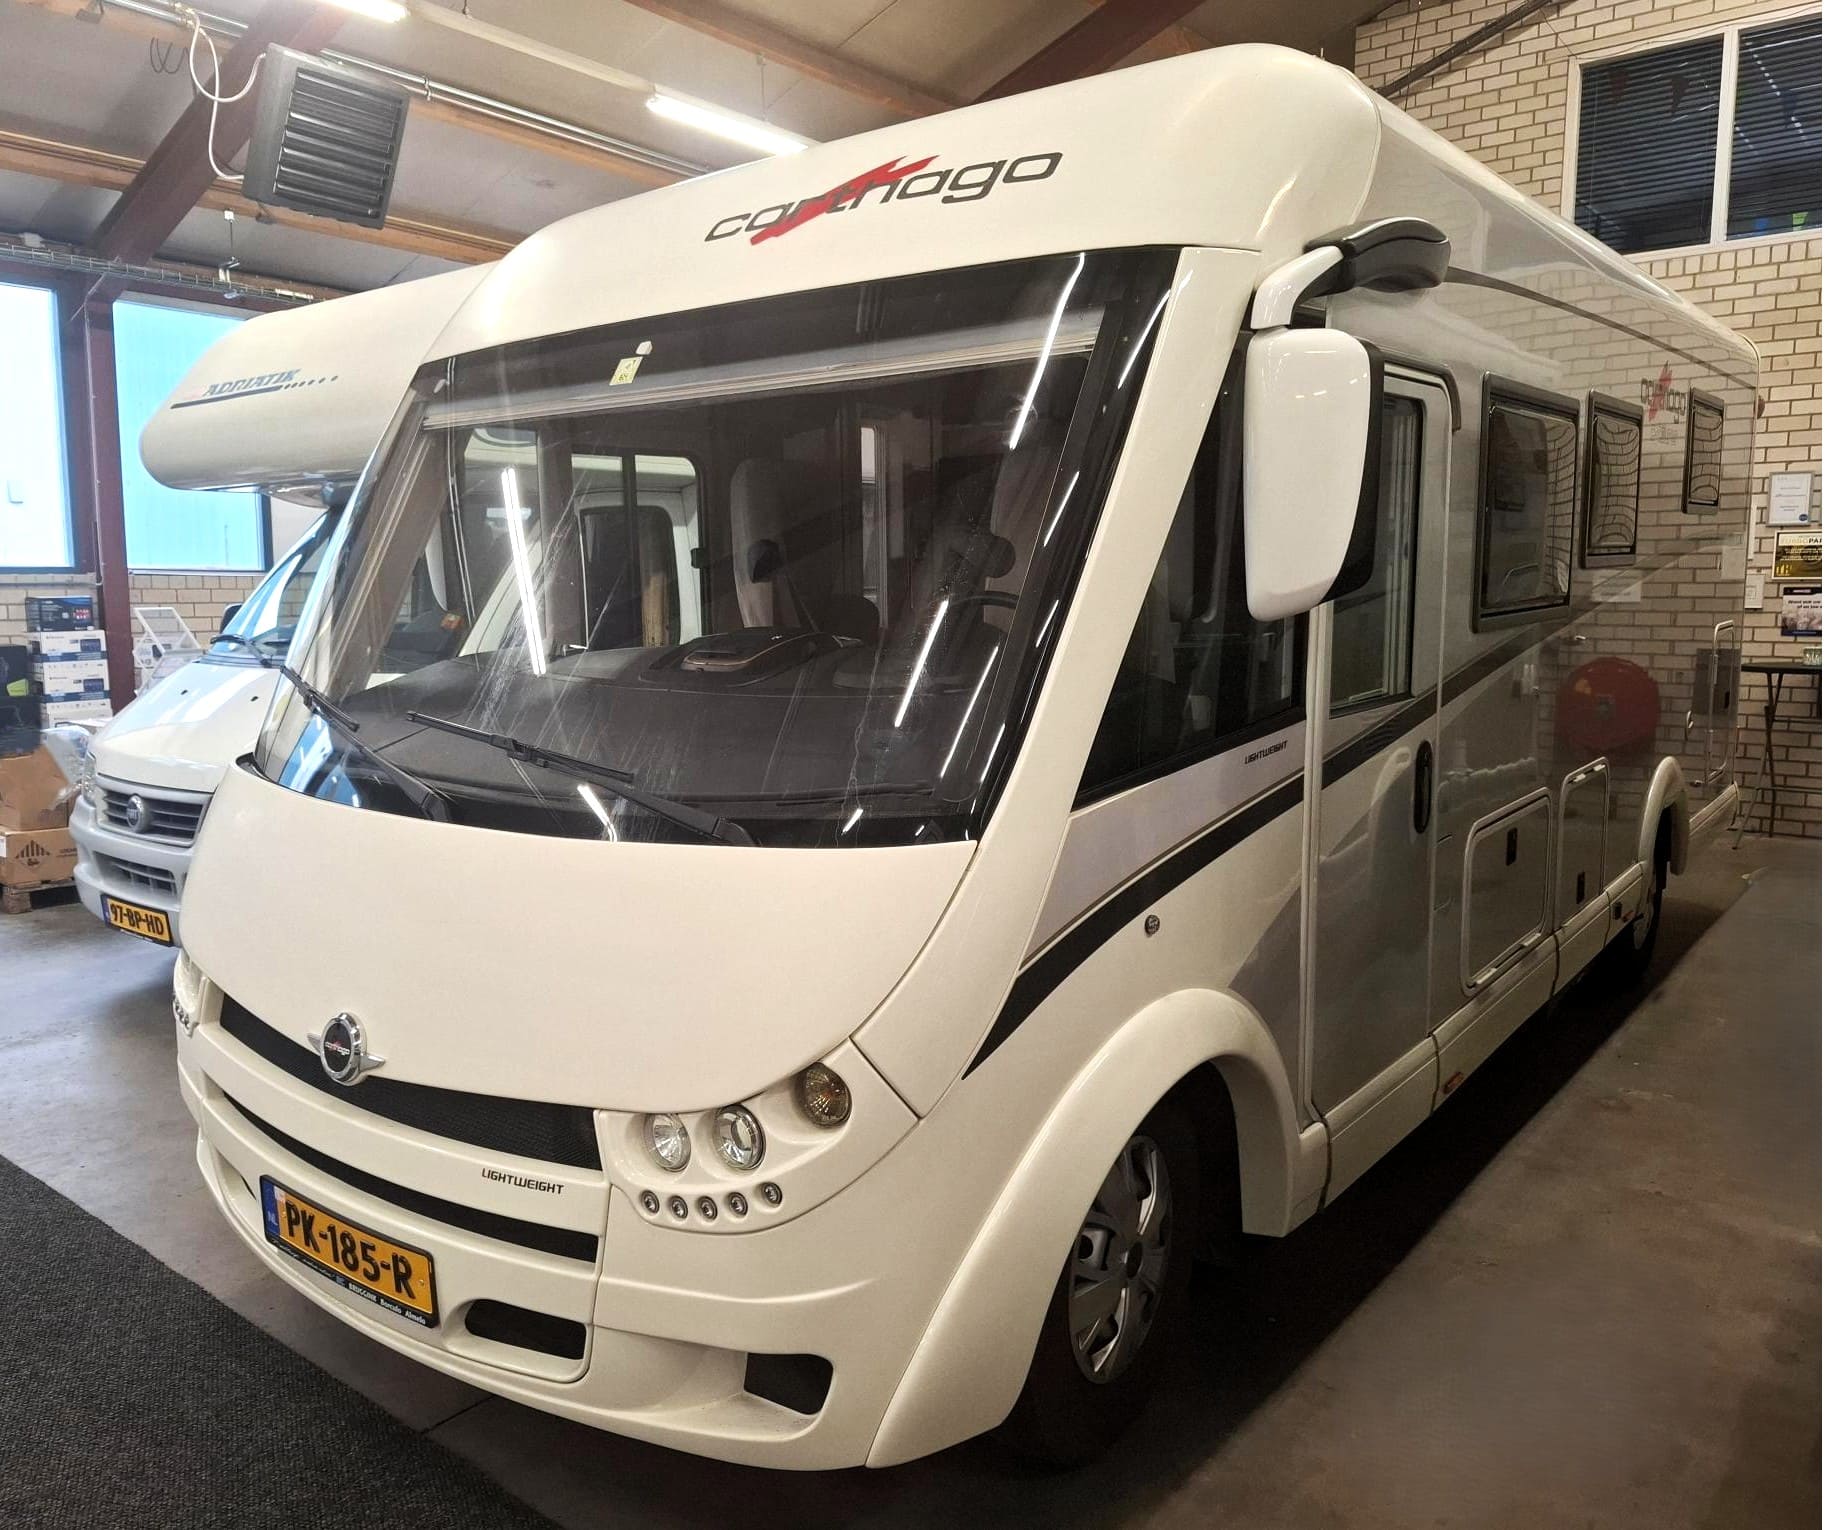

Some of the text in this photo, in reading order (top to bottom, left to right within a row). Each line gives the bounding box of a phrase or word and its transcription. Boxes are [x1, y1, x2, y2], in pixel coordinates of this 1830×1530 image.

[1244, 740, 1288, 765] LIGHTWEIGHT
[110, 903, 164, 936] 97-BP-HD
[481, 1167, 564, 1195] LIGHTWEIGHT
[285, 1199, 416, 1300] PK-185-R
